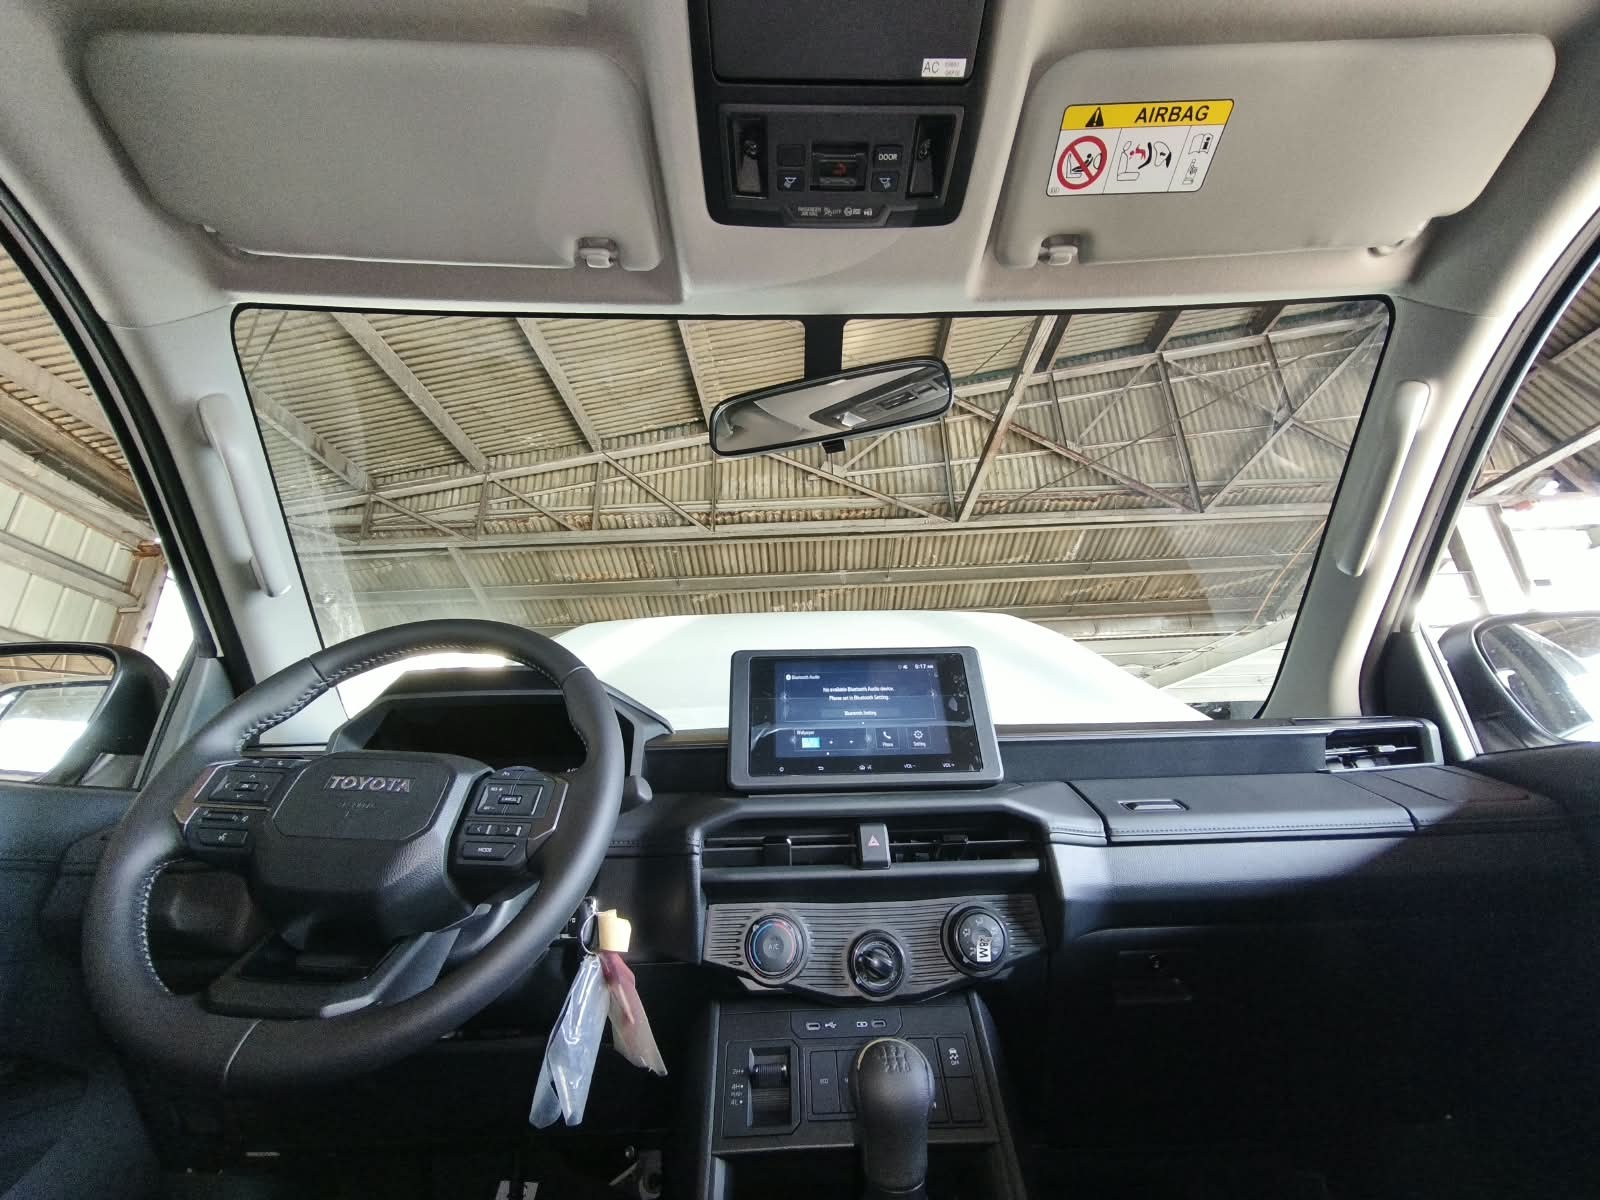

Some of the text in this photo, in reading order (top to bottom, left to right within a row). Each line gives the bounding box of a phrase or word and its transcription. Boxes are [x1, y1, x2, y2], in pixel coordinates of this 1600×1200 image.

[922, 60, 940, 74] AC
[1134, 105, 1210, 123] AIRBAG
[878, 152, 898, 161] DOOR
[329, 775, 411, 793] TOYOTA
[768, 943, 780, 951] A/C
